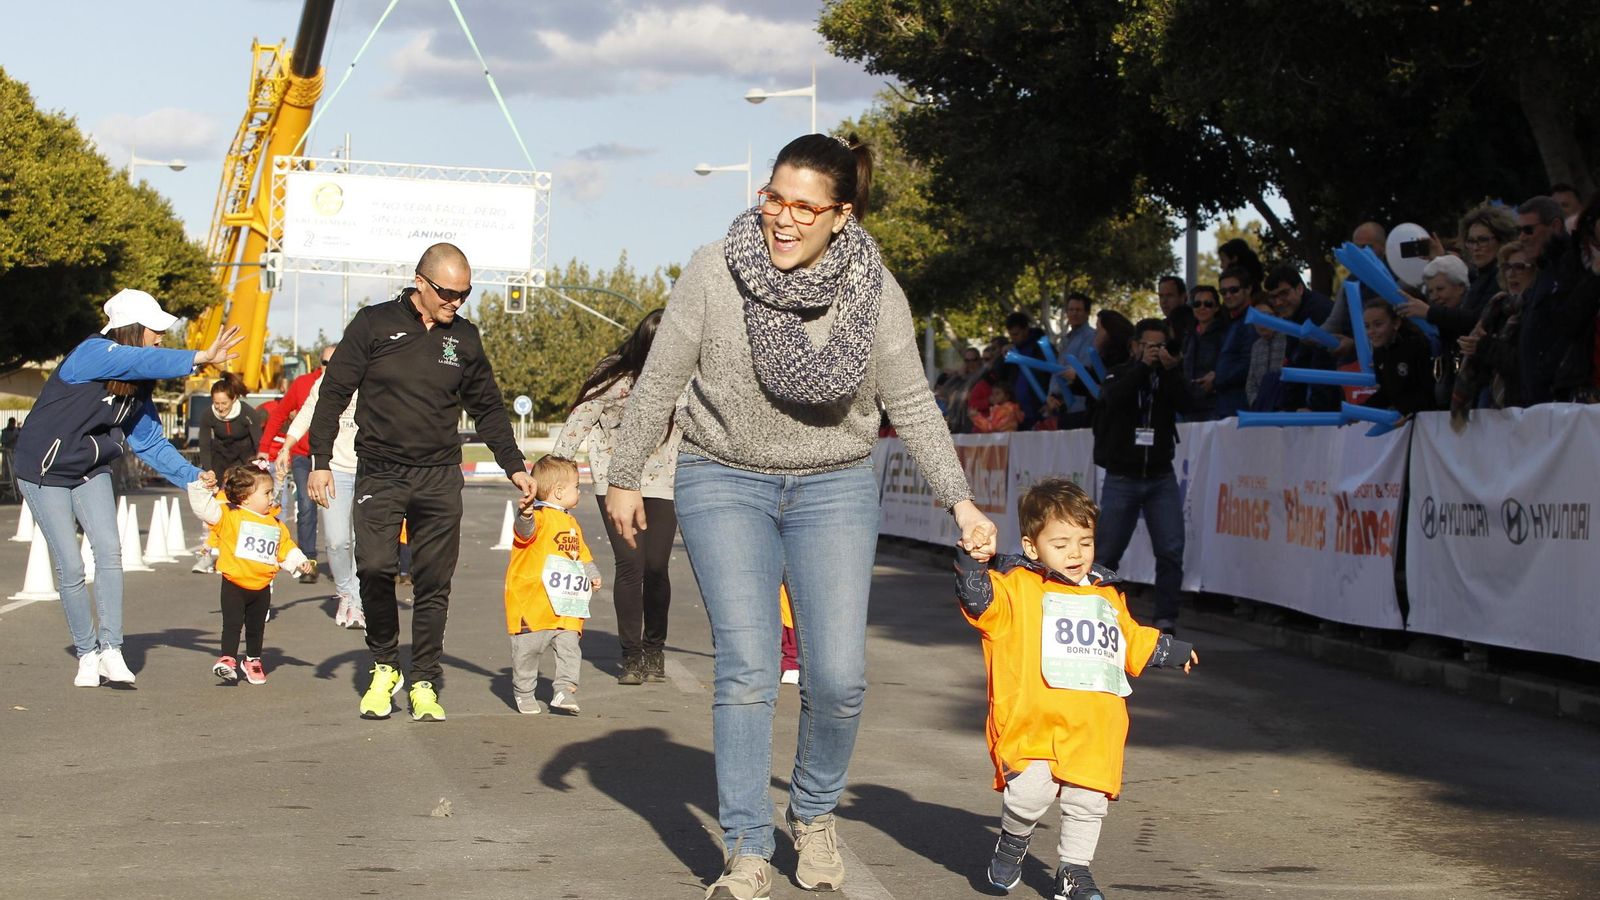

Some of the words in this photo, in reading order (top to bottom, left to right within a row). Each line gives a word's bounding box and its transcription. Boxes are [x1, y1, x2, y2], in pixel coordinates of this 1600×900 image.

[1216, 482, 1270, 541] Blanes
[1439, 502, 1489, 537] HYUNDAI
[1530, 502, 1590, 540] HYUNDAI
[549, 572, 590, 592] 8130
[1055, 618, 1119, 653] 8039
[1066, 646, 1090, 655] BORN
[1093, 648, 1102, 656] TO
[1103, 650, 1115, 659] RUN
